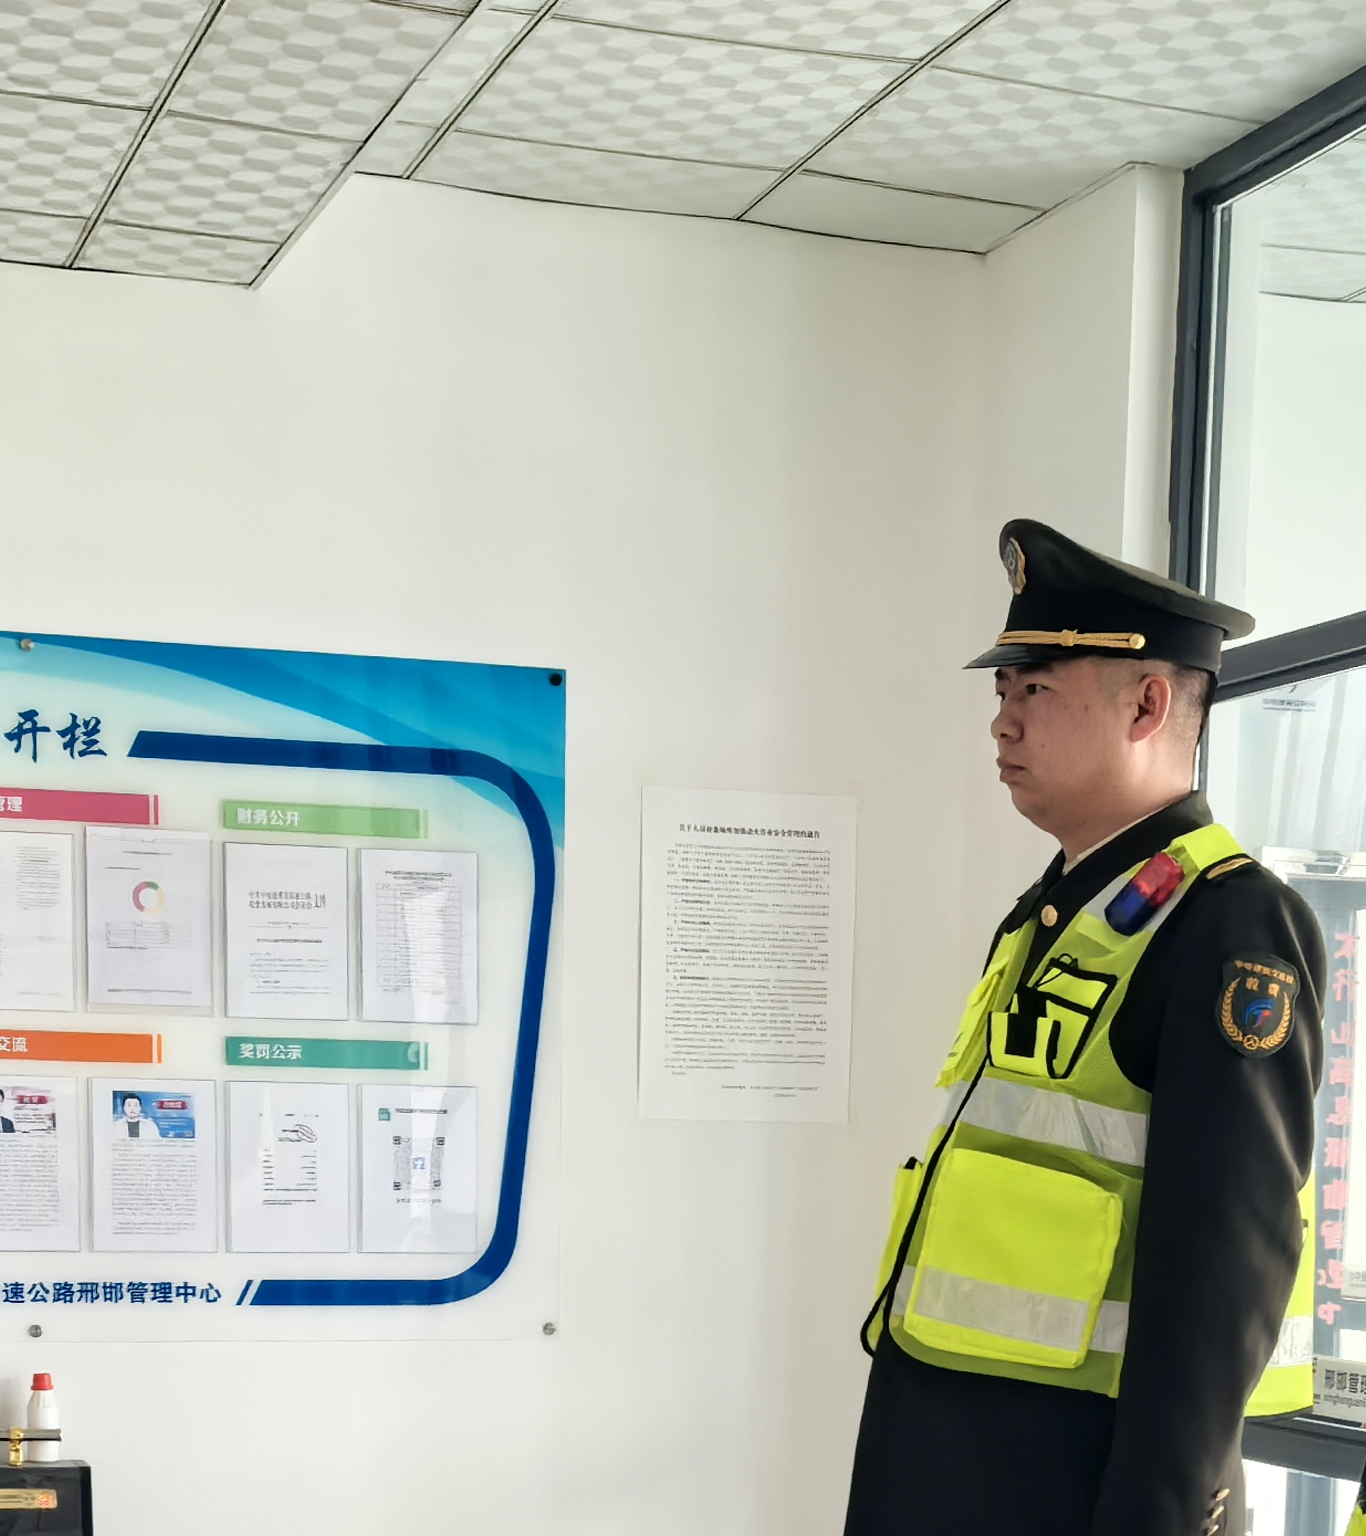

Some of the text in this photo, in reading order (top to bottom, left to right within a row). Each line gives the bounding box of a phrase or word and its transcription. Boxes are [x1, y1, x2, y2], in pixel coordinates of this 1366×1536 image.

[236, 807, 301, 826] 财务公开
[238, 1043, 303, 1060] 奖罚公示
